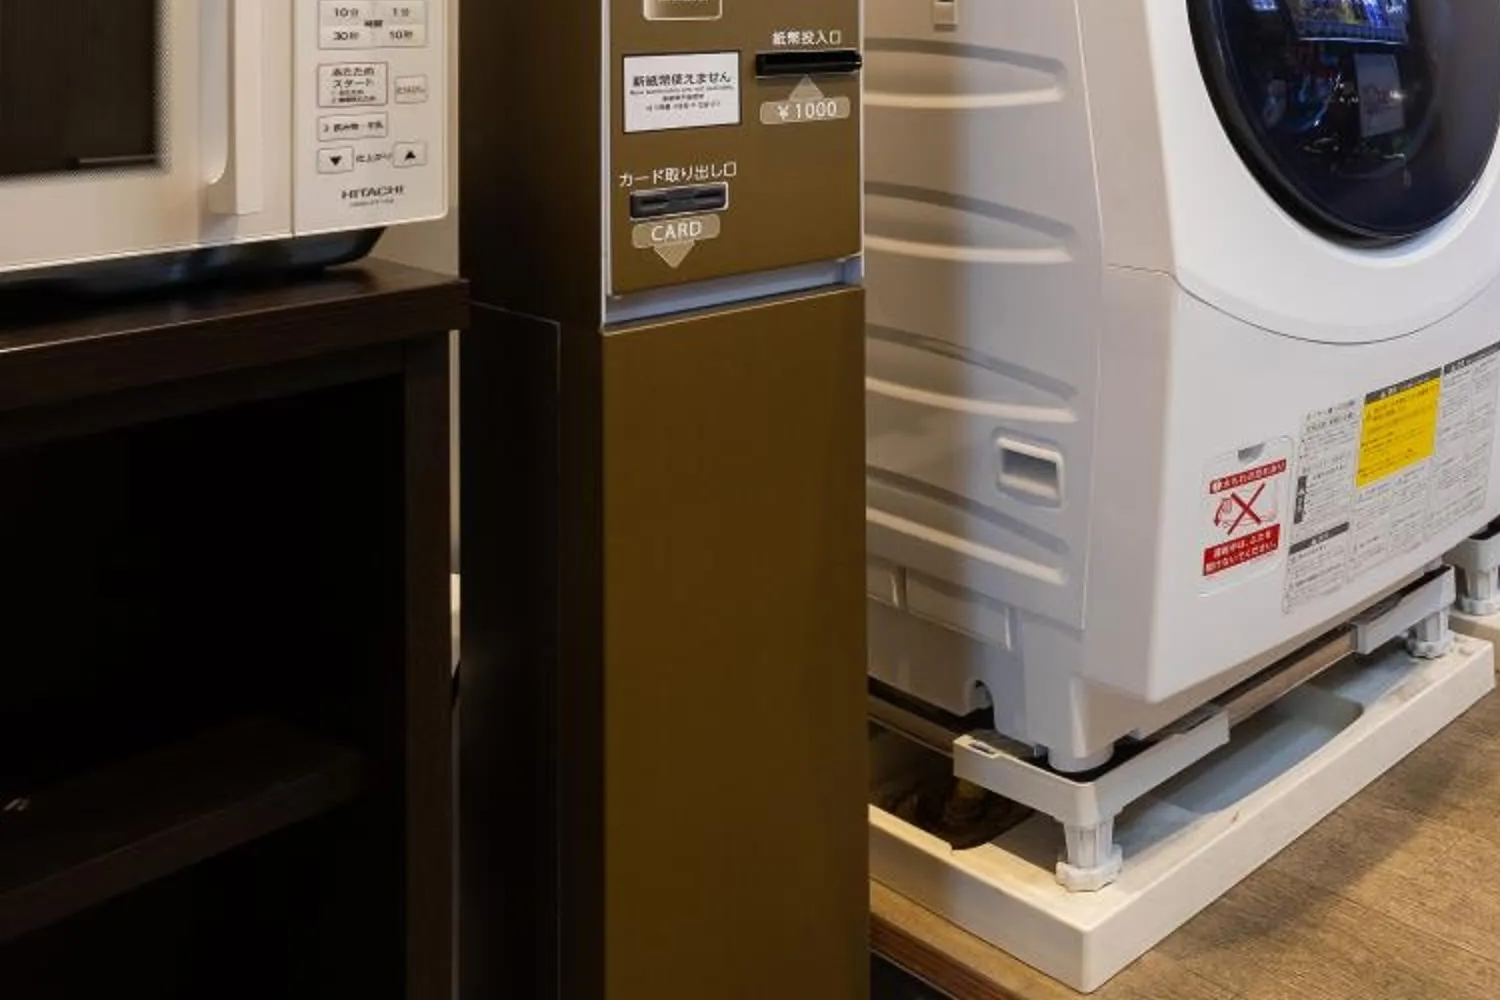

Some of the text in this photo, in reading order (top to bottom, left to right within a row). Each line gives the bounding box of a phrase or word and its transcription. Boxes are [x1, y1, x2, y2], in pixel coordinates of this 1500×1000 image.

[771, 29, 842, 46] 紙幣投入口
[619, 161, 738, 188] カード取り出し口
[341, 184, 404, 200] HITACHI
[651, 221, 703, 241] CARD
